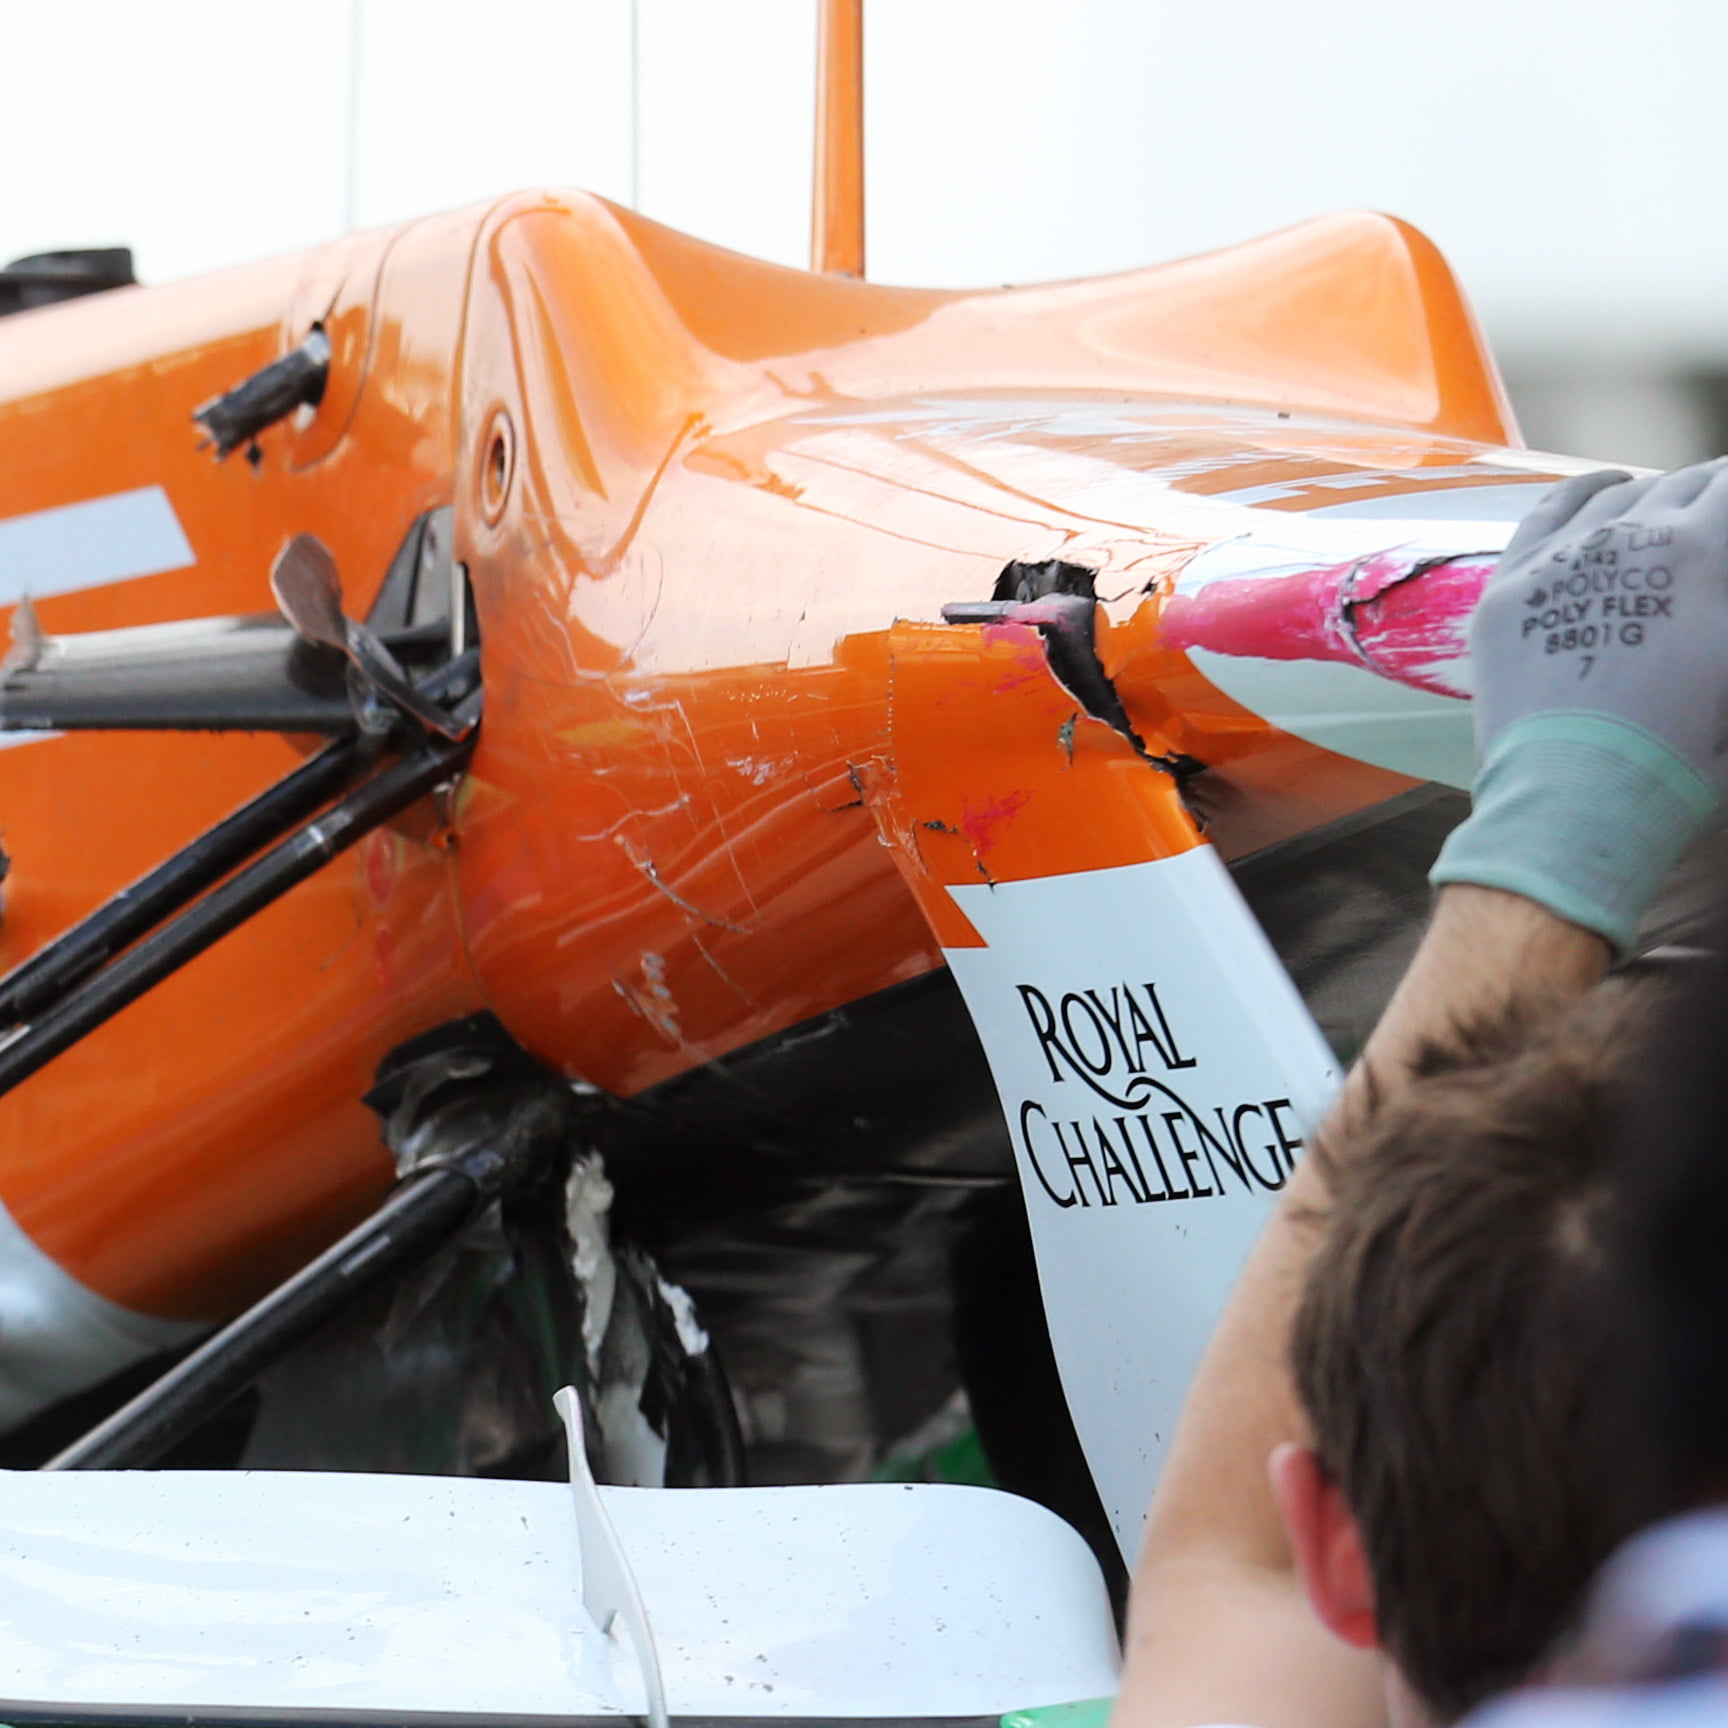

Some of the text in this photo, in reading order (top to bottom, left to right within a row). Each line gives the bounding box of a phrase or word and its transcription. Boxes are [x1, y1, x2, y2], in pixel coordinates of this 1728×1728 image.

[1521, 594, 1674, 639] POLY FLEX
[1552, 565, 1674, 600] POLYCO
[1015, 980, 1197, 1108] ROYAL
[1019, 1096, 1308, 1209] CHALLENGE
